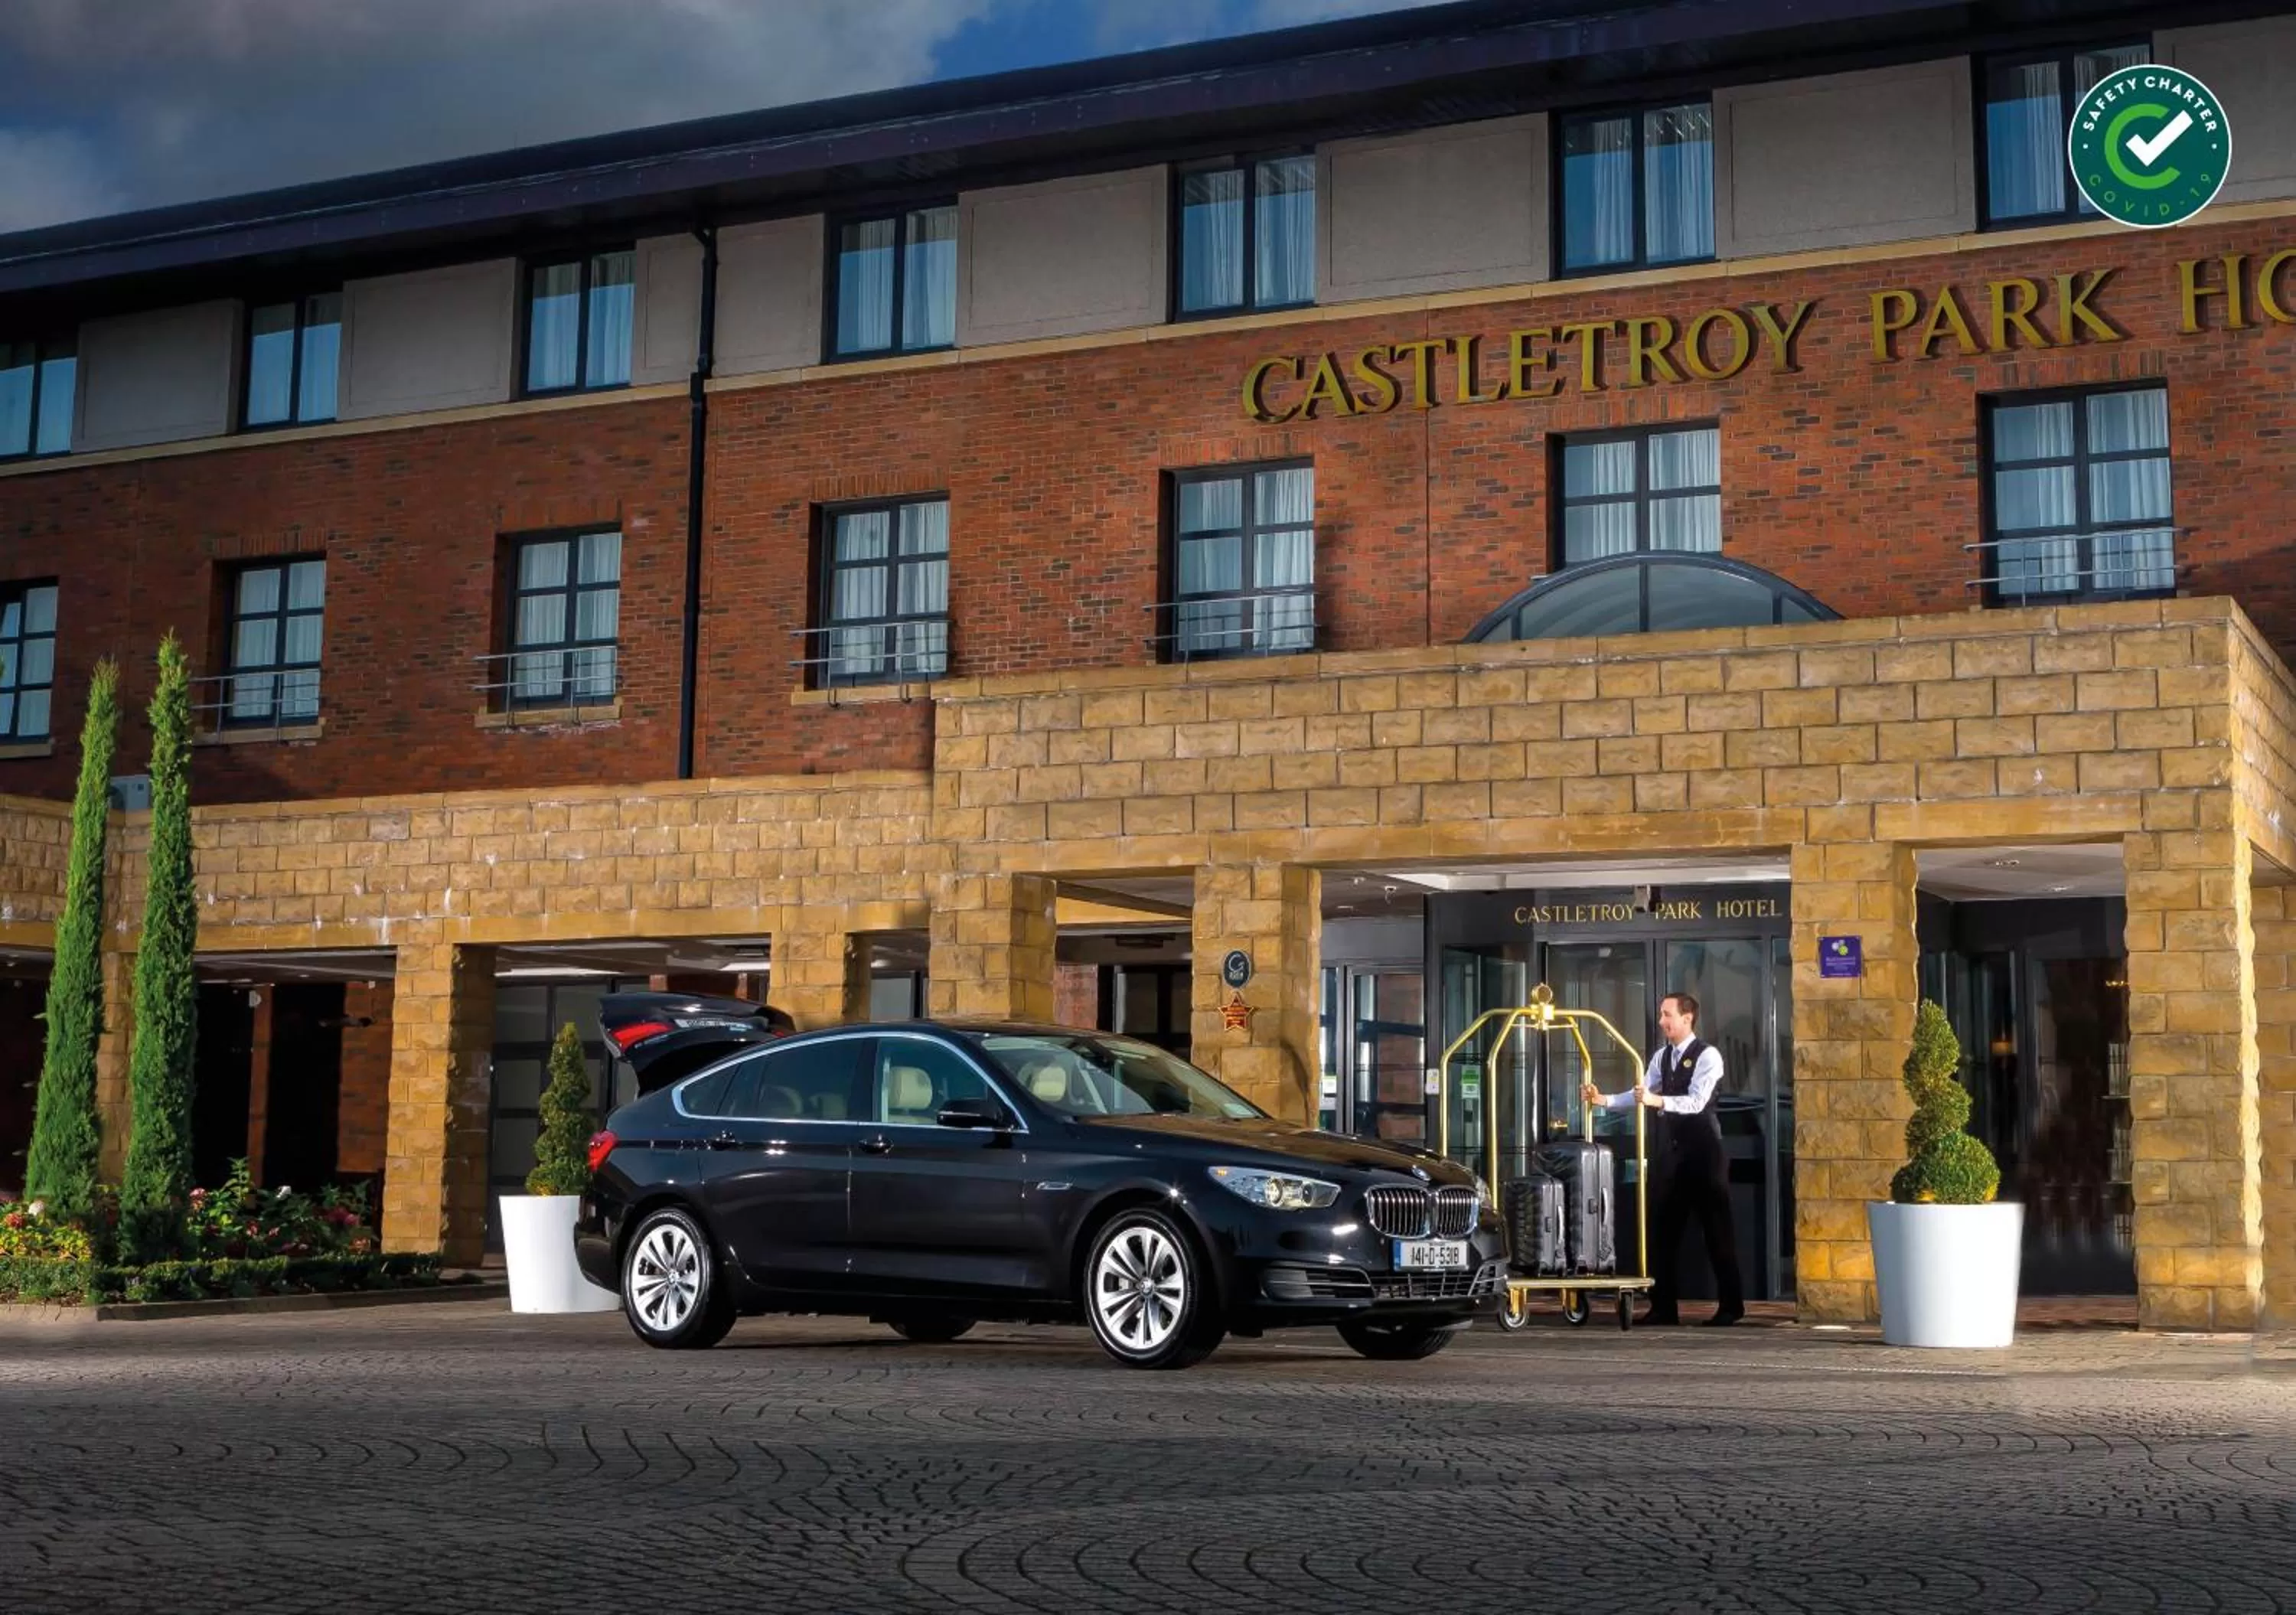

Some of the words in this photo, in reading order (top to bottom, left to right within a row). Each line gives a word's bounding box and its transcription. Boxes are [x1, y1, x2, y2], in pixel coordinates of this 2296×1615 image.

[1241, 297, 1823, 424] CASTLETROY
[1868, 266, 2135, 364] PARK
[1514, 903, 1636, 925] CASTLETROY
[1655, 900, 1703, 920] PARK
[1717, 899, 1783, 918] HOTEL
